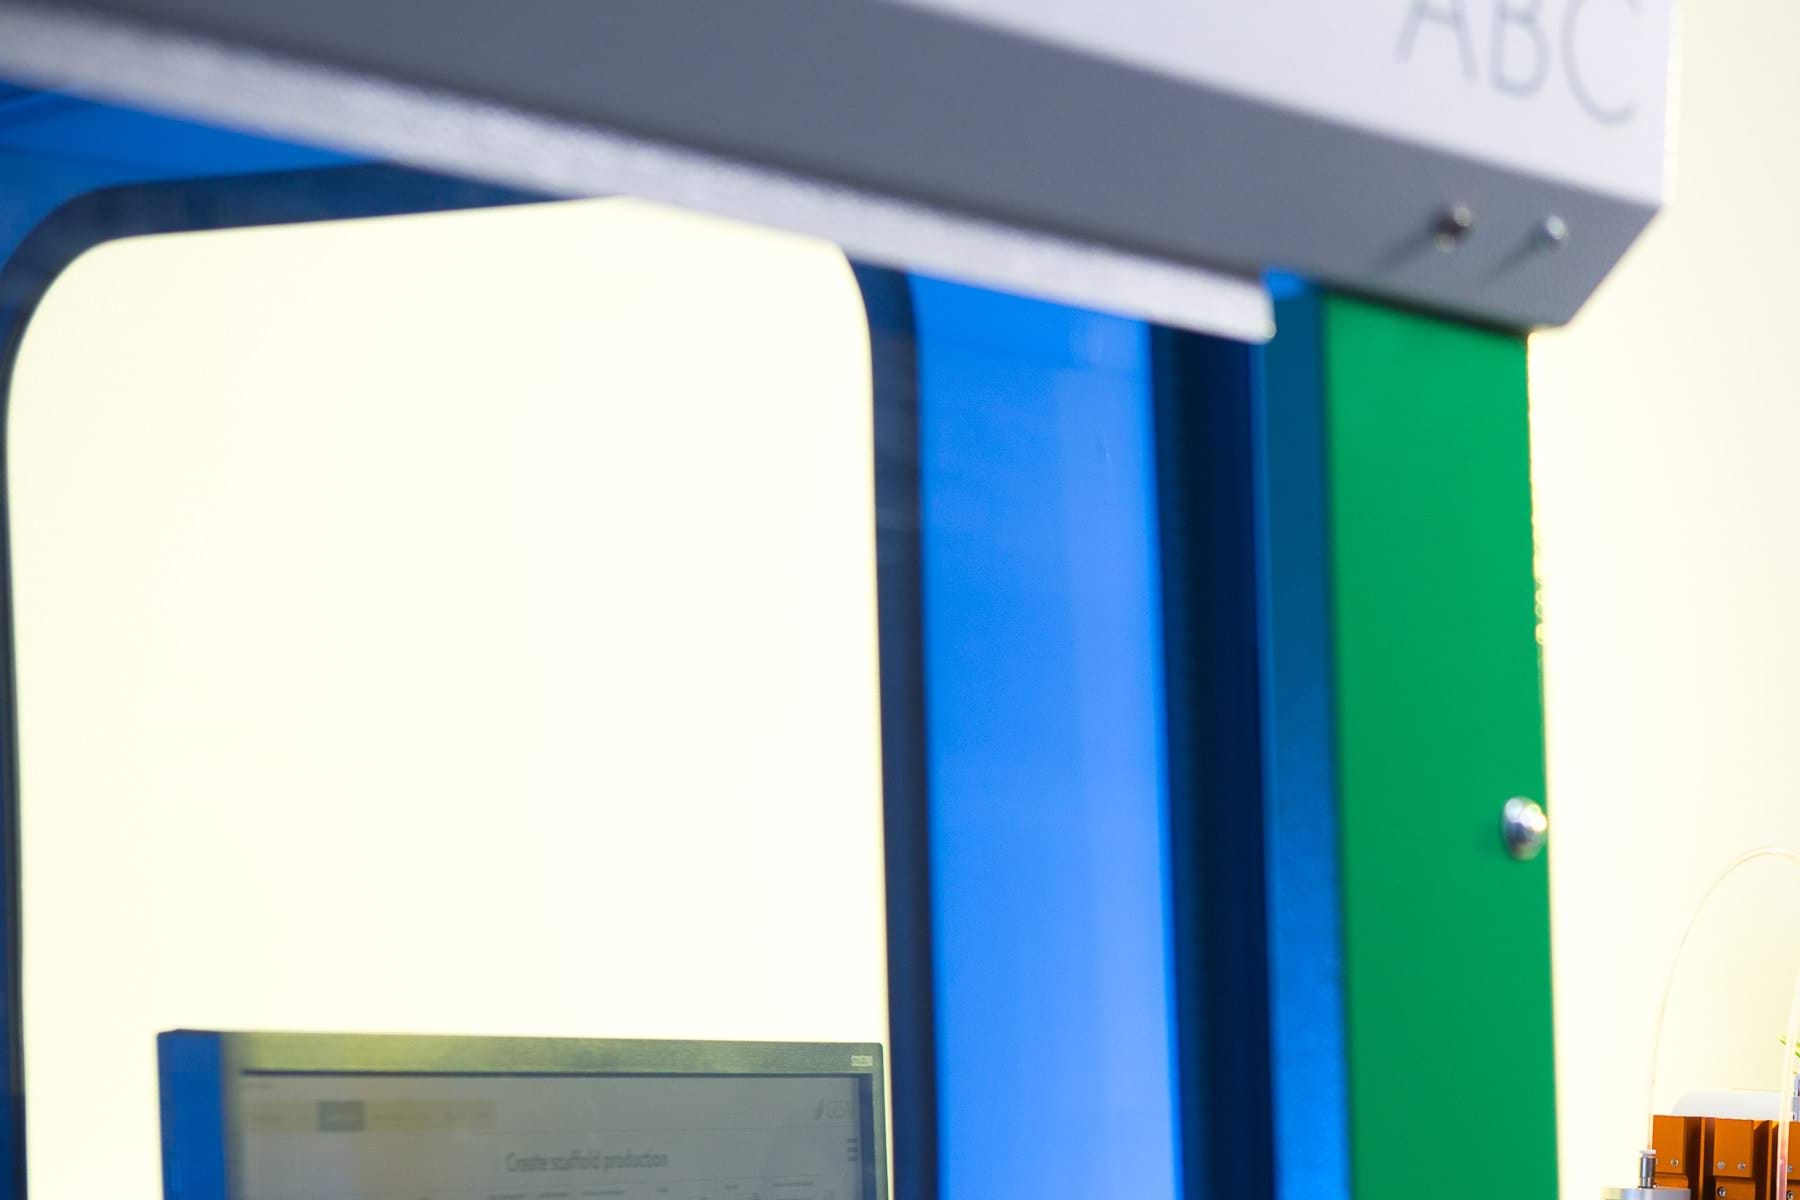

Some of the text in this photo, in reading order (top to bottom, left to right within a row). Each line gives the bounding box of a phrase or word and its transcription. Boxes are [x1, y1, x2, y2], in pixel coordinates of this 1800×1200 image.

[1394, 0, 1640, 127] ABC
[505, 1148, 670, 1175] Create scaffold production
